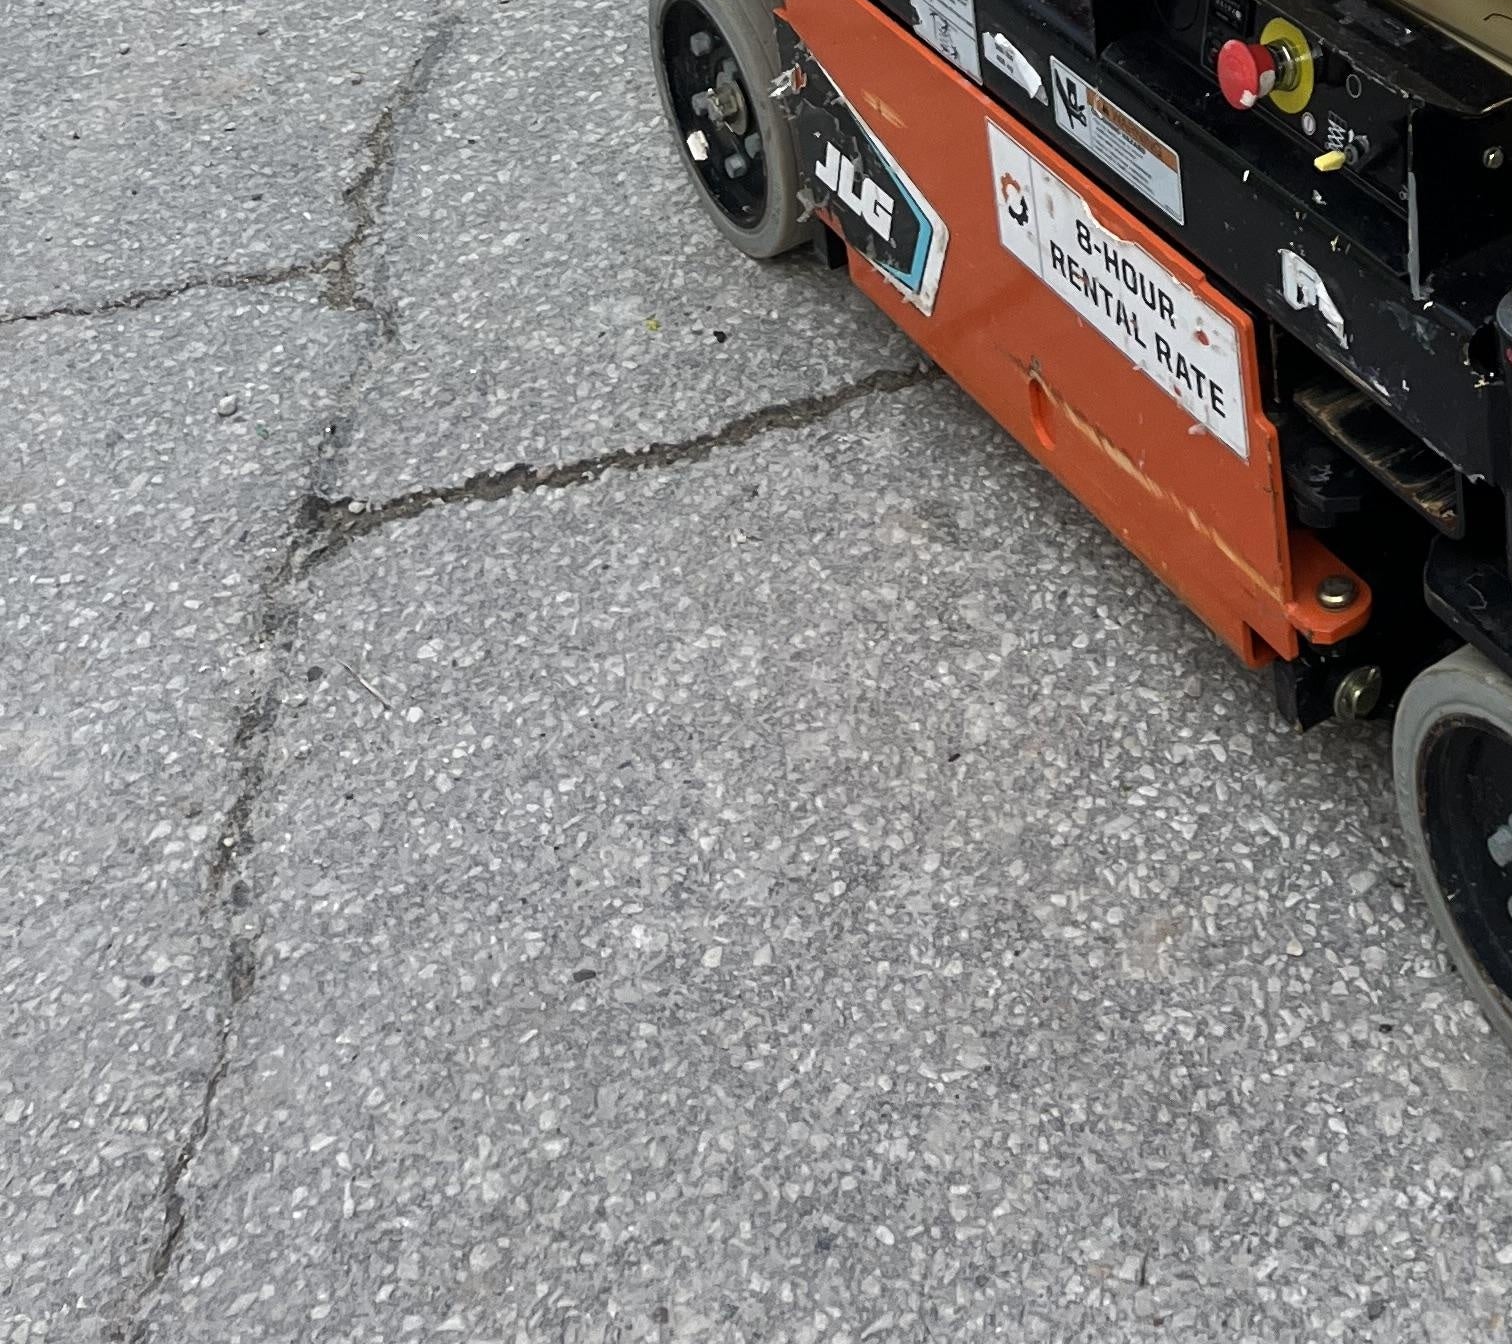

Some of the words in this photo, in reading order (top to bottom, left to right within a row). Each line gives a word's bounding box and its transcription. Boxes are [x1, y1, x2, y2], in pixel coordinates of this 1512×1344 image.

[815, 141, 895, 242] JLG
[1050, 239, 1147, 349] RENTAL
[1154, 331, 1227, 419] RATE
[1075, 218, 1177, 330] 8-HOUR
